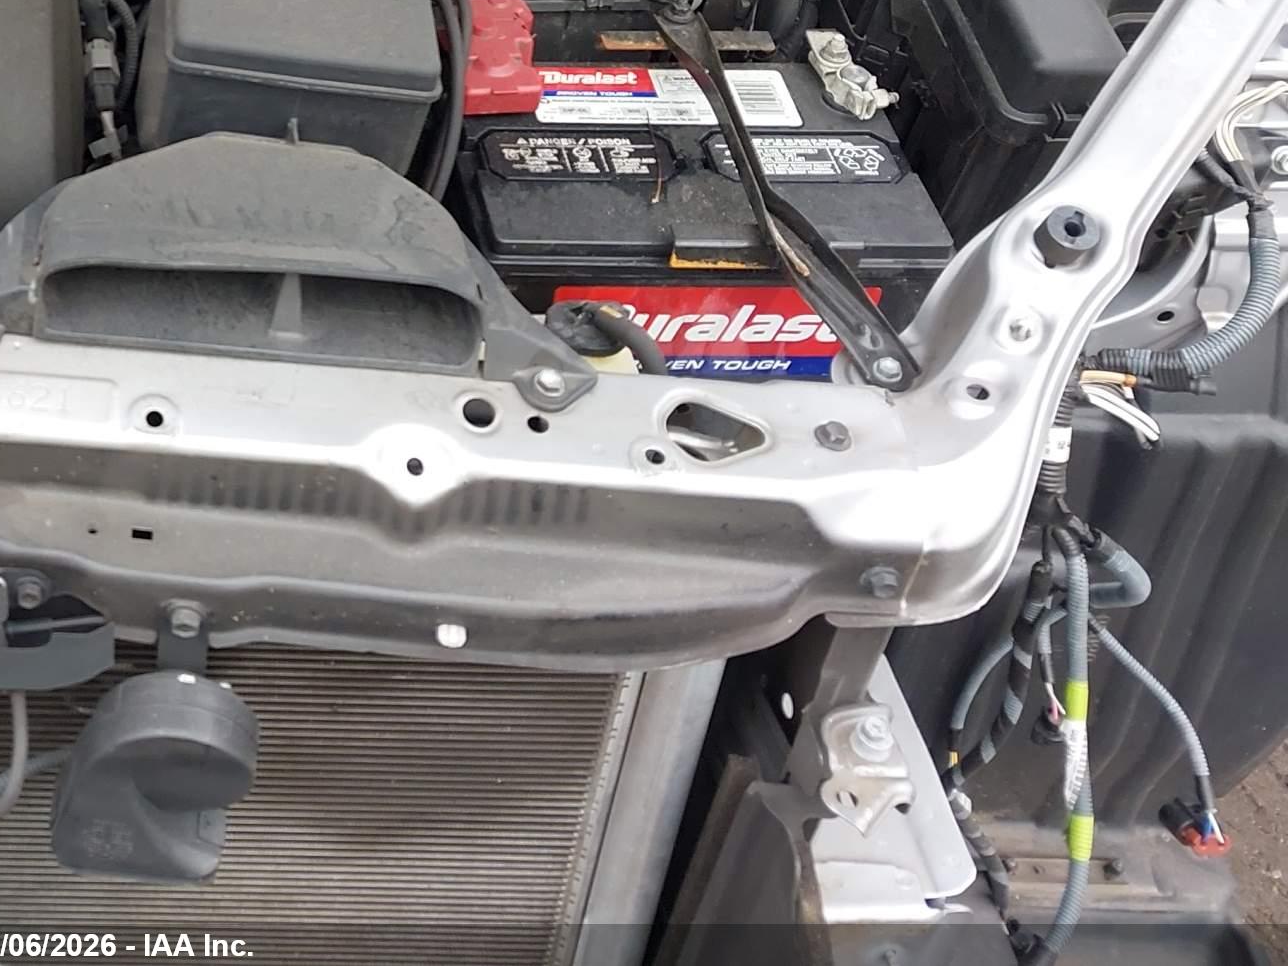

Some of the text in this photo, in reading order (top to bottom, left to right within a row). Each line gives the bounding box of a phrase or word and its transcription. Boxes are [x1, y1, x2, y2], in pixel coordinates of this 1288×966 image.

[538, 70, 638, 85] Duralast
[528, 137, 577, 146] DANGER
[587, 137, 632, 146] POISON
[621, 304, 838, 343] uralas
[713, 359, 793, 371] TOUGH
